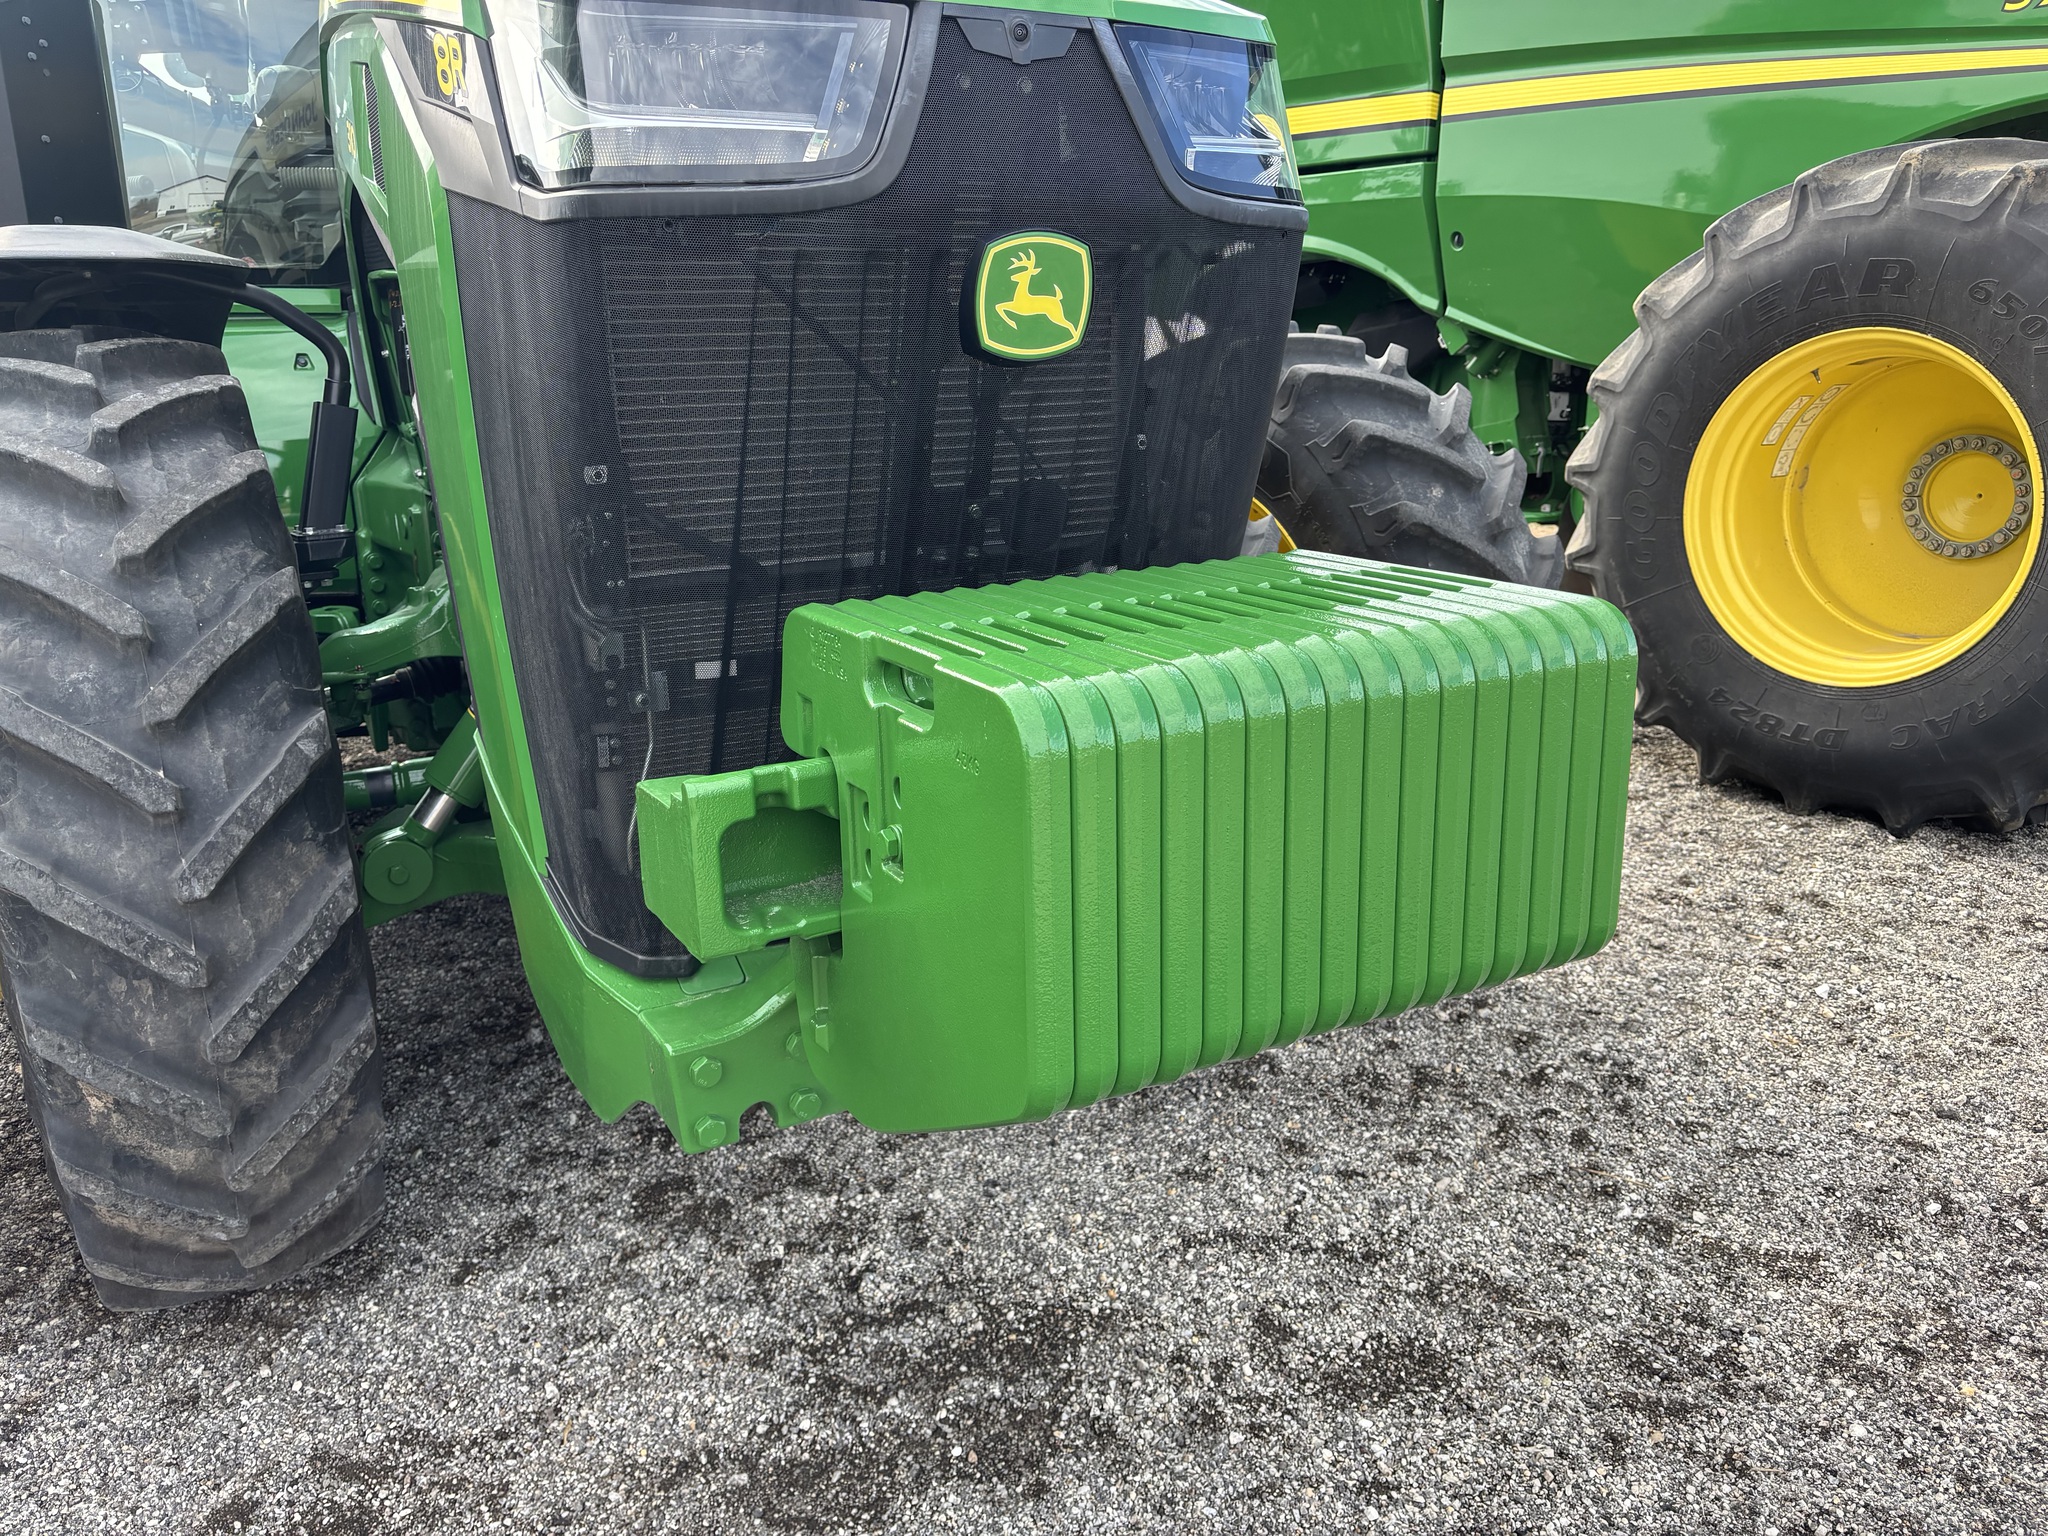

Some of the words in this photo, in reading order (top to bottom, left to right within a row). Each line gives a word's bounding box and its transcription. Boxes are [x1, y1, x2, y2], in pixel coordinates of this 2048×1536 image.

[433, 31, 469, 98] 8R
[1967, 278, 2048, 355] 650
[1623, 257, 1916, 580] GOODYEAR
[1706, 686, 1849, 752] DT824
